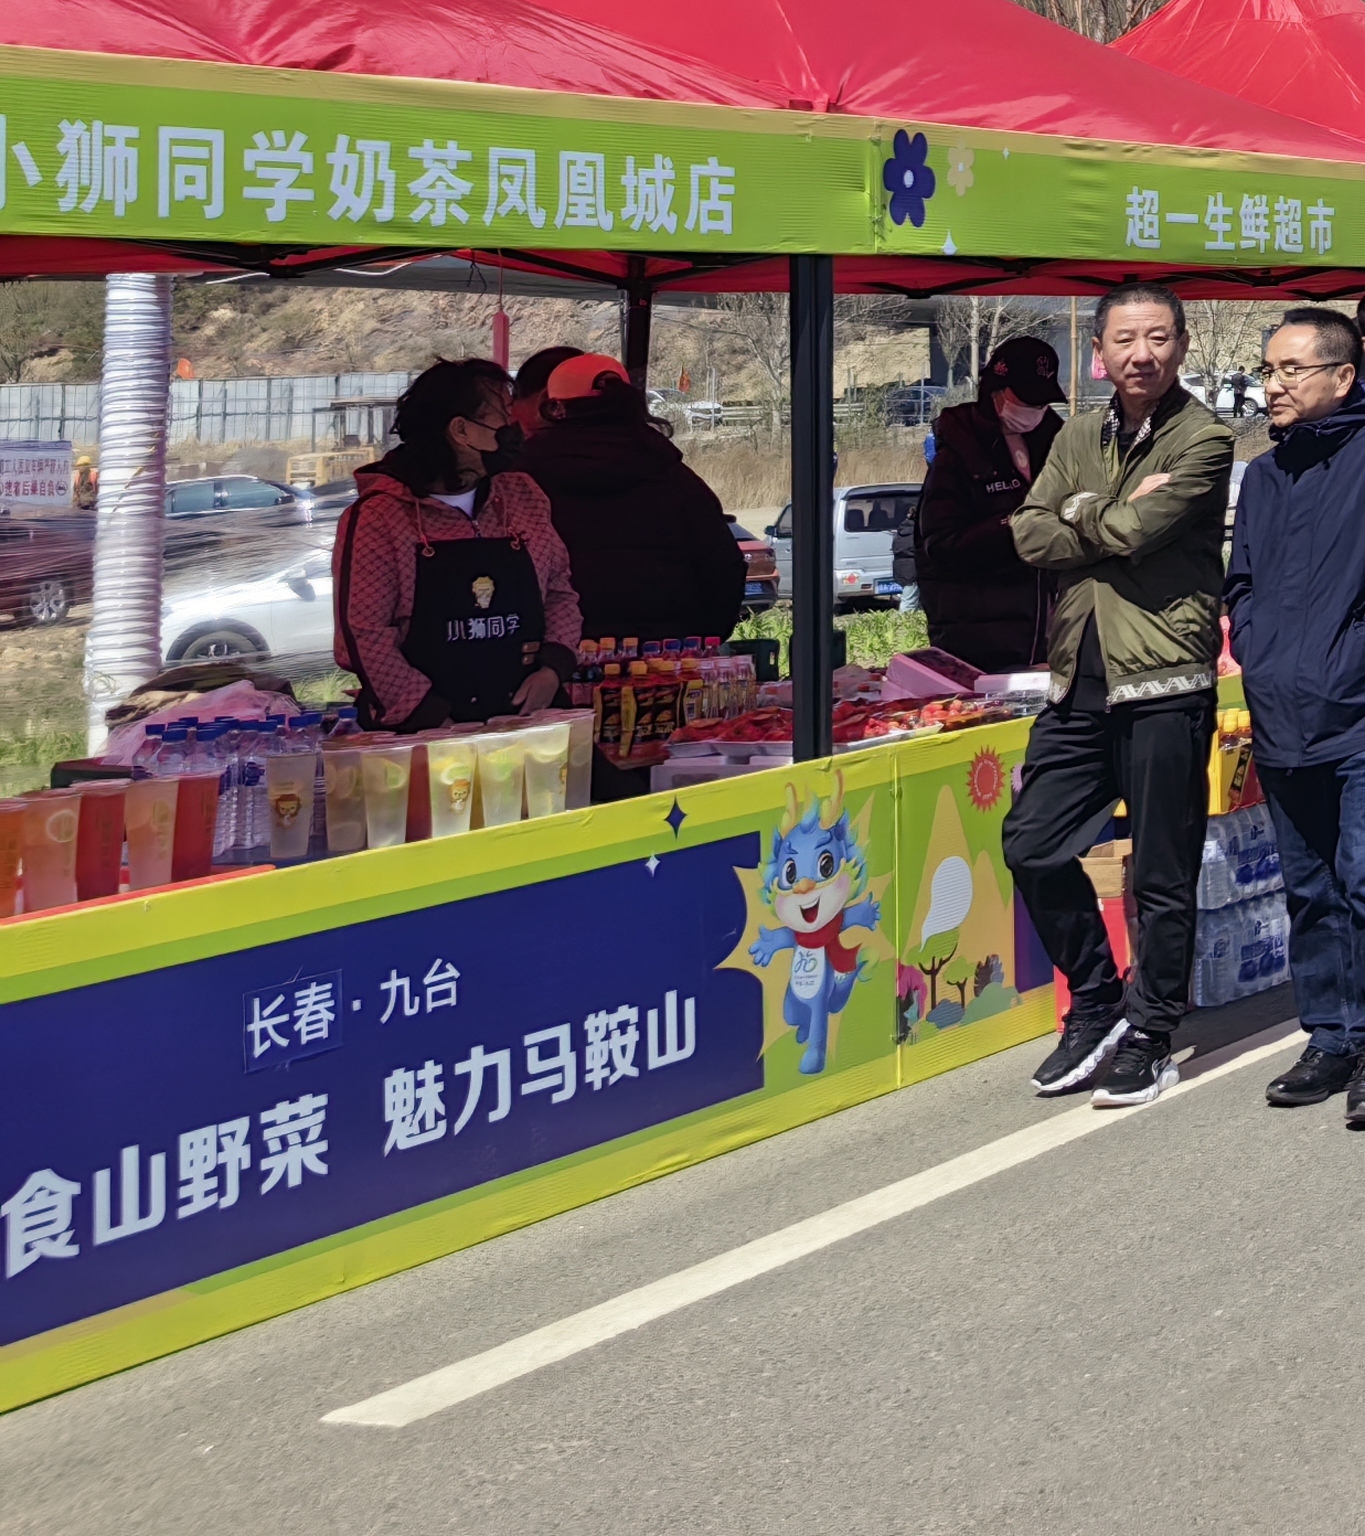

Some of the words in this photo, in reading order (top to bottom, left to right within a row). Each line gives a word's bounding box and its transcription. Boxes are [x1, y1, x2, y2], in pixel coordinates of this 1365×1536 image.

[1125, 185, 1335, 256] 超一生鲜超市
[447, 613, 520, 642] 小狮同学
[0, 1092, 329, 1280] 食山野菜
[383, 989, 697, 1157] 魅力马鞍山
